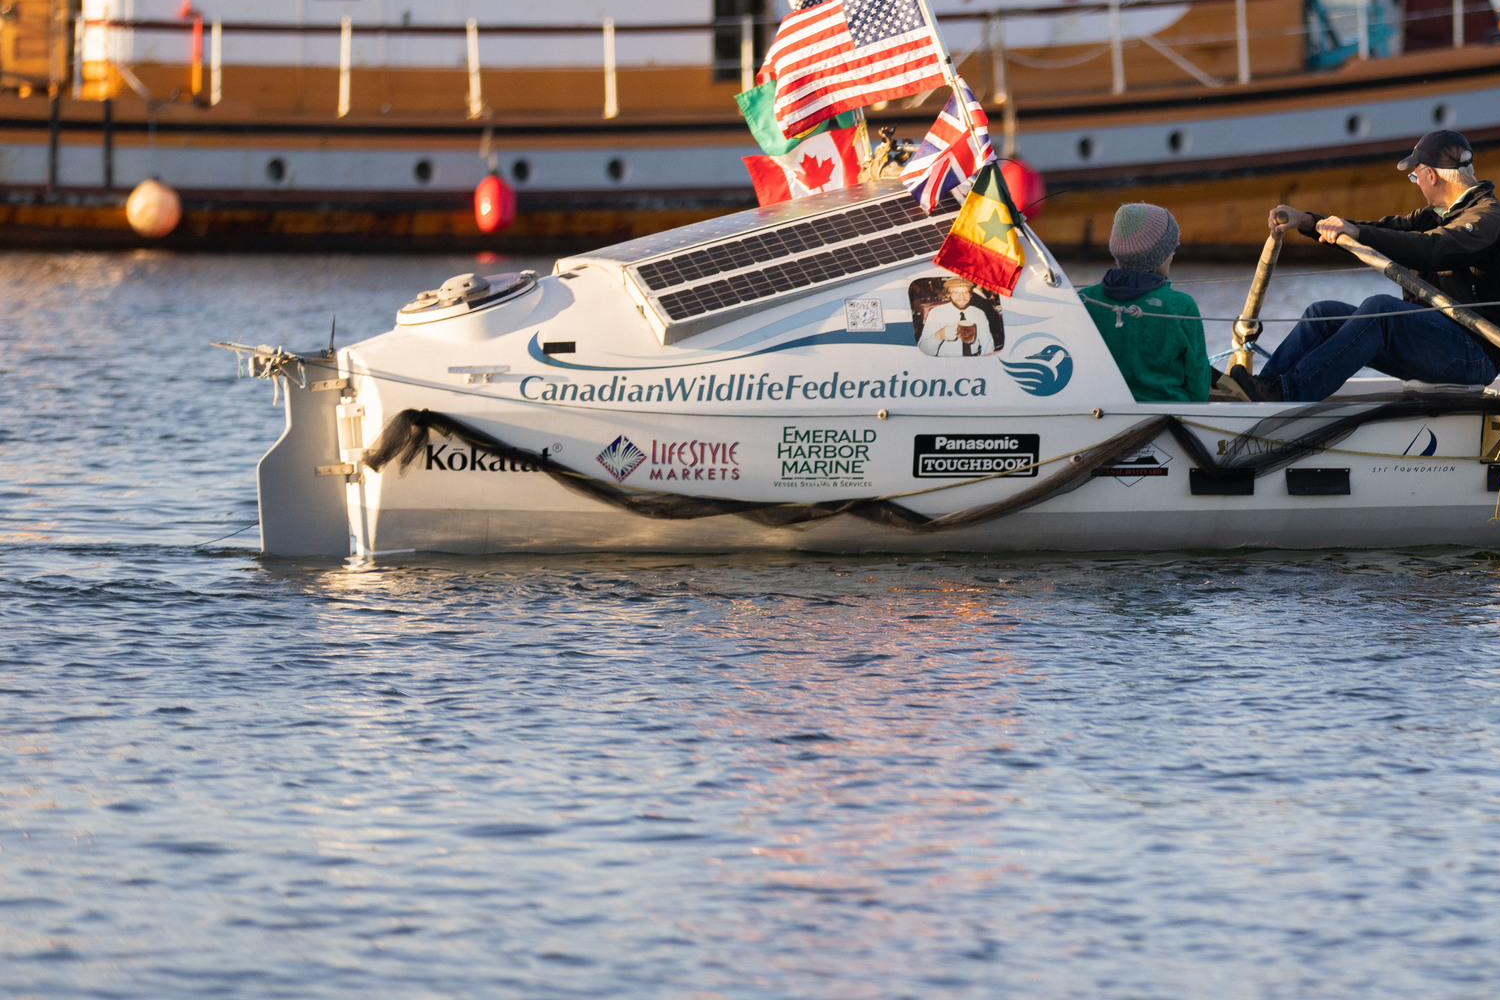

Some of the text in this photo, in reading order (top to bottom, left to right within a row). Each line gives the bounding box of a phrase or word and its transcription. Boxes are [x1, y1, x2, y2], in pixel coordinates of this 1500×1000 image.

[519, 371, 986, 403] CanadianWildlifeFederation.ca
[783, 426, 877, 443] EMERALD
[935, 436, 1019, 450] Panasonic
[777, 442, 870, 461] HARBOR
[781, 460, 864, 477] MARINE
[924, 458, 1029, 471] TOUGHBOOK
[1394, 465, 1456, 473] FOUNDATION
[649, 468, 740, 480] MARKETS
[1125, 468, 1163, 476] BOATYARD
